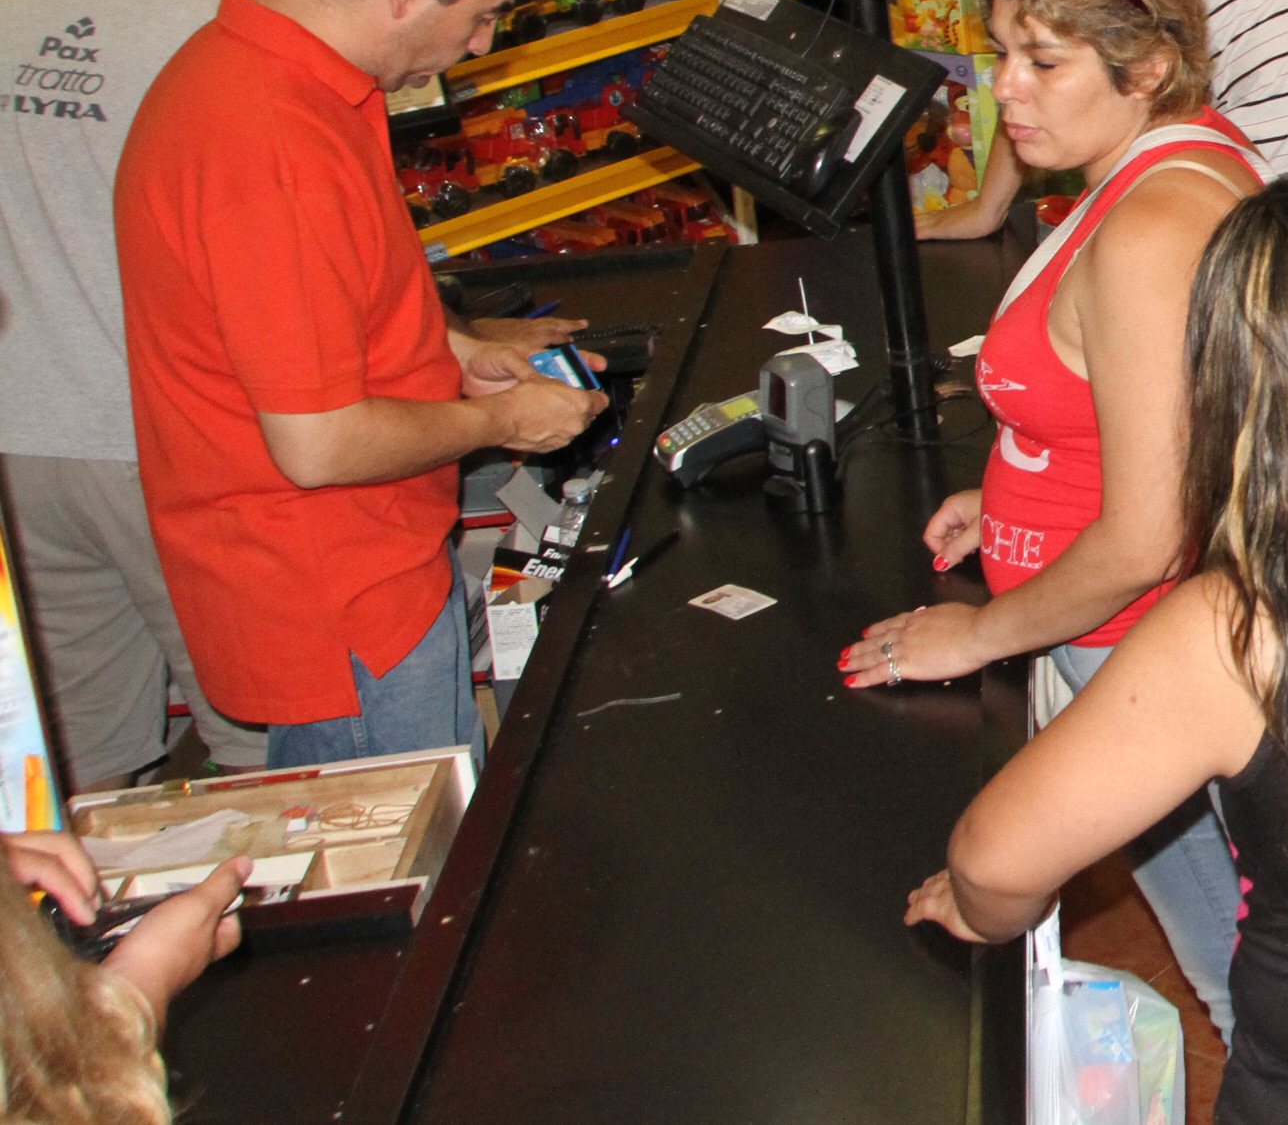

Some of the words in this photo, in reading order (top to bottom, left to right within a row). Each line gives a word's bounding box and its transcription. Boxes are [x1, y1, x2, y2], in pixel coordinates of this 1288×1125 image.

[39, 36, 100, 63] Pax
[14, 94, 108, 122] LYRA
[521, 557, 566, 580] Ener
